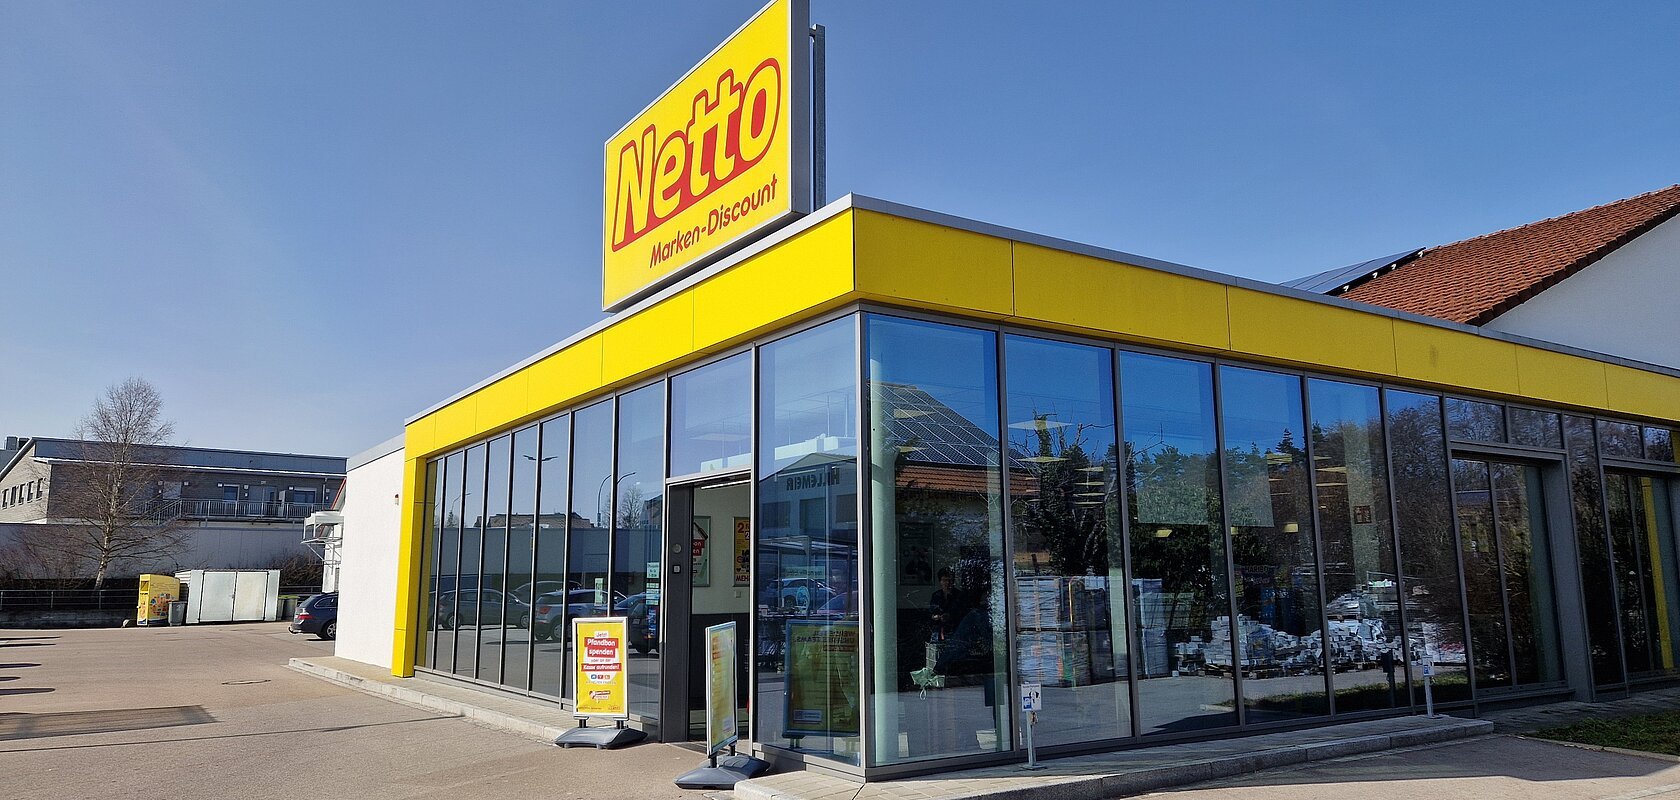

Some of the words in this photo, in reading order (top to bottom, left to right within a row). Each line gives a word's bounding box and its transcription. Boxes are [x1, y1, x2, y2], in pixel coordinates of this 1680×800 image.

[612, 57, 781, 252] Netto
[649, 173, 777, 268] Marken-Discount
[737, 522, 745, 533] 2
